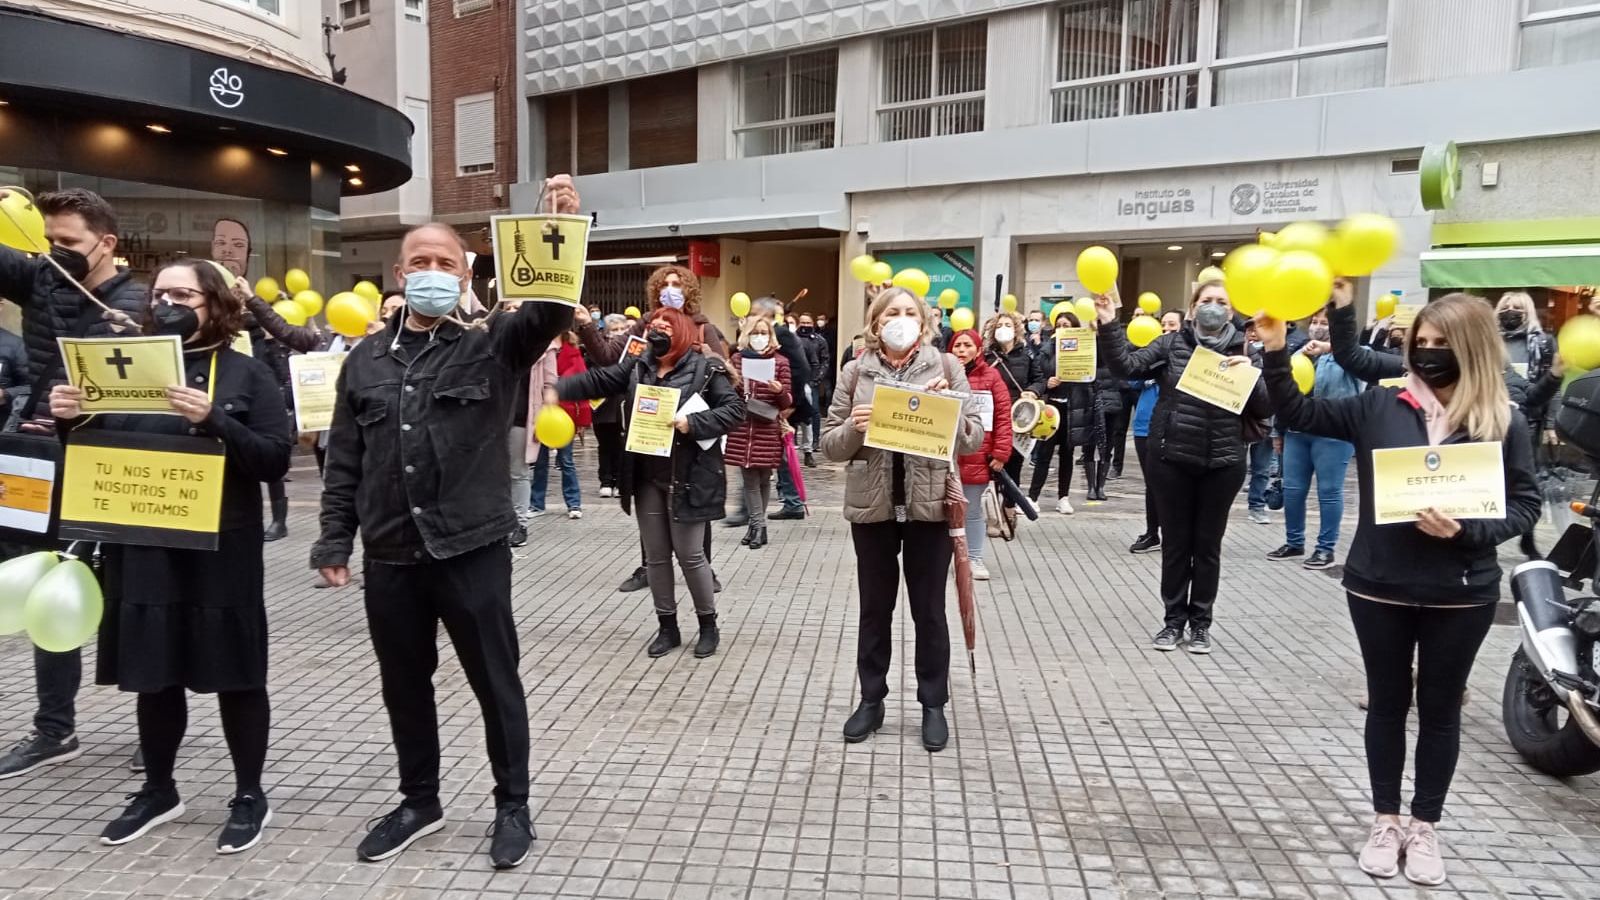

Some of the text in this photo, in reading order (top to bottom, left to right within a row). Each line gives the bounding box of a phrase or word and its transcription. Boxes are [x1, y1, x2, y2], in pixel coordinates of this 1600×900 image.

[1263, 178, 1319, 190] Universidad
[1134, 188, 1191, 199] Instituto de
[1303, 188, 1315, 197] de
[1117, 198, 1195, 220] lenguas
[1263, 199, 1301, 208] Valencia
[517, 267, 575, 285] BARBERIA
[84, 385, 168, 399] PERRUQUERI
[892, 412, 934, 426] ESTETICA
[937, 444, 949, 456] YA
[96, 462, 205, 482] TU NOS VETAS
[1406, 474, 1467, 486] ESTETICA
[94, 480, 199, 500] NOSOTROS NO
[93, 497, 189, 517] TE VOTAMOS
[1480, 500, 1499, 514] YA
